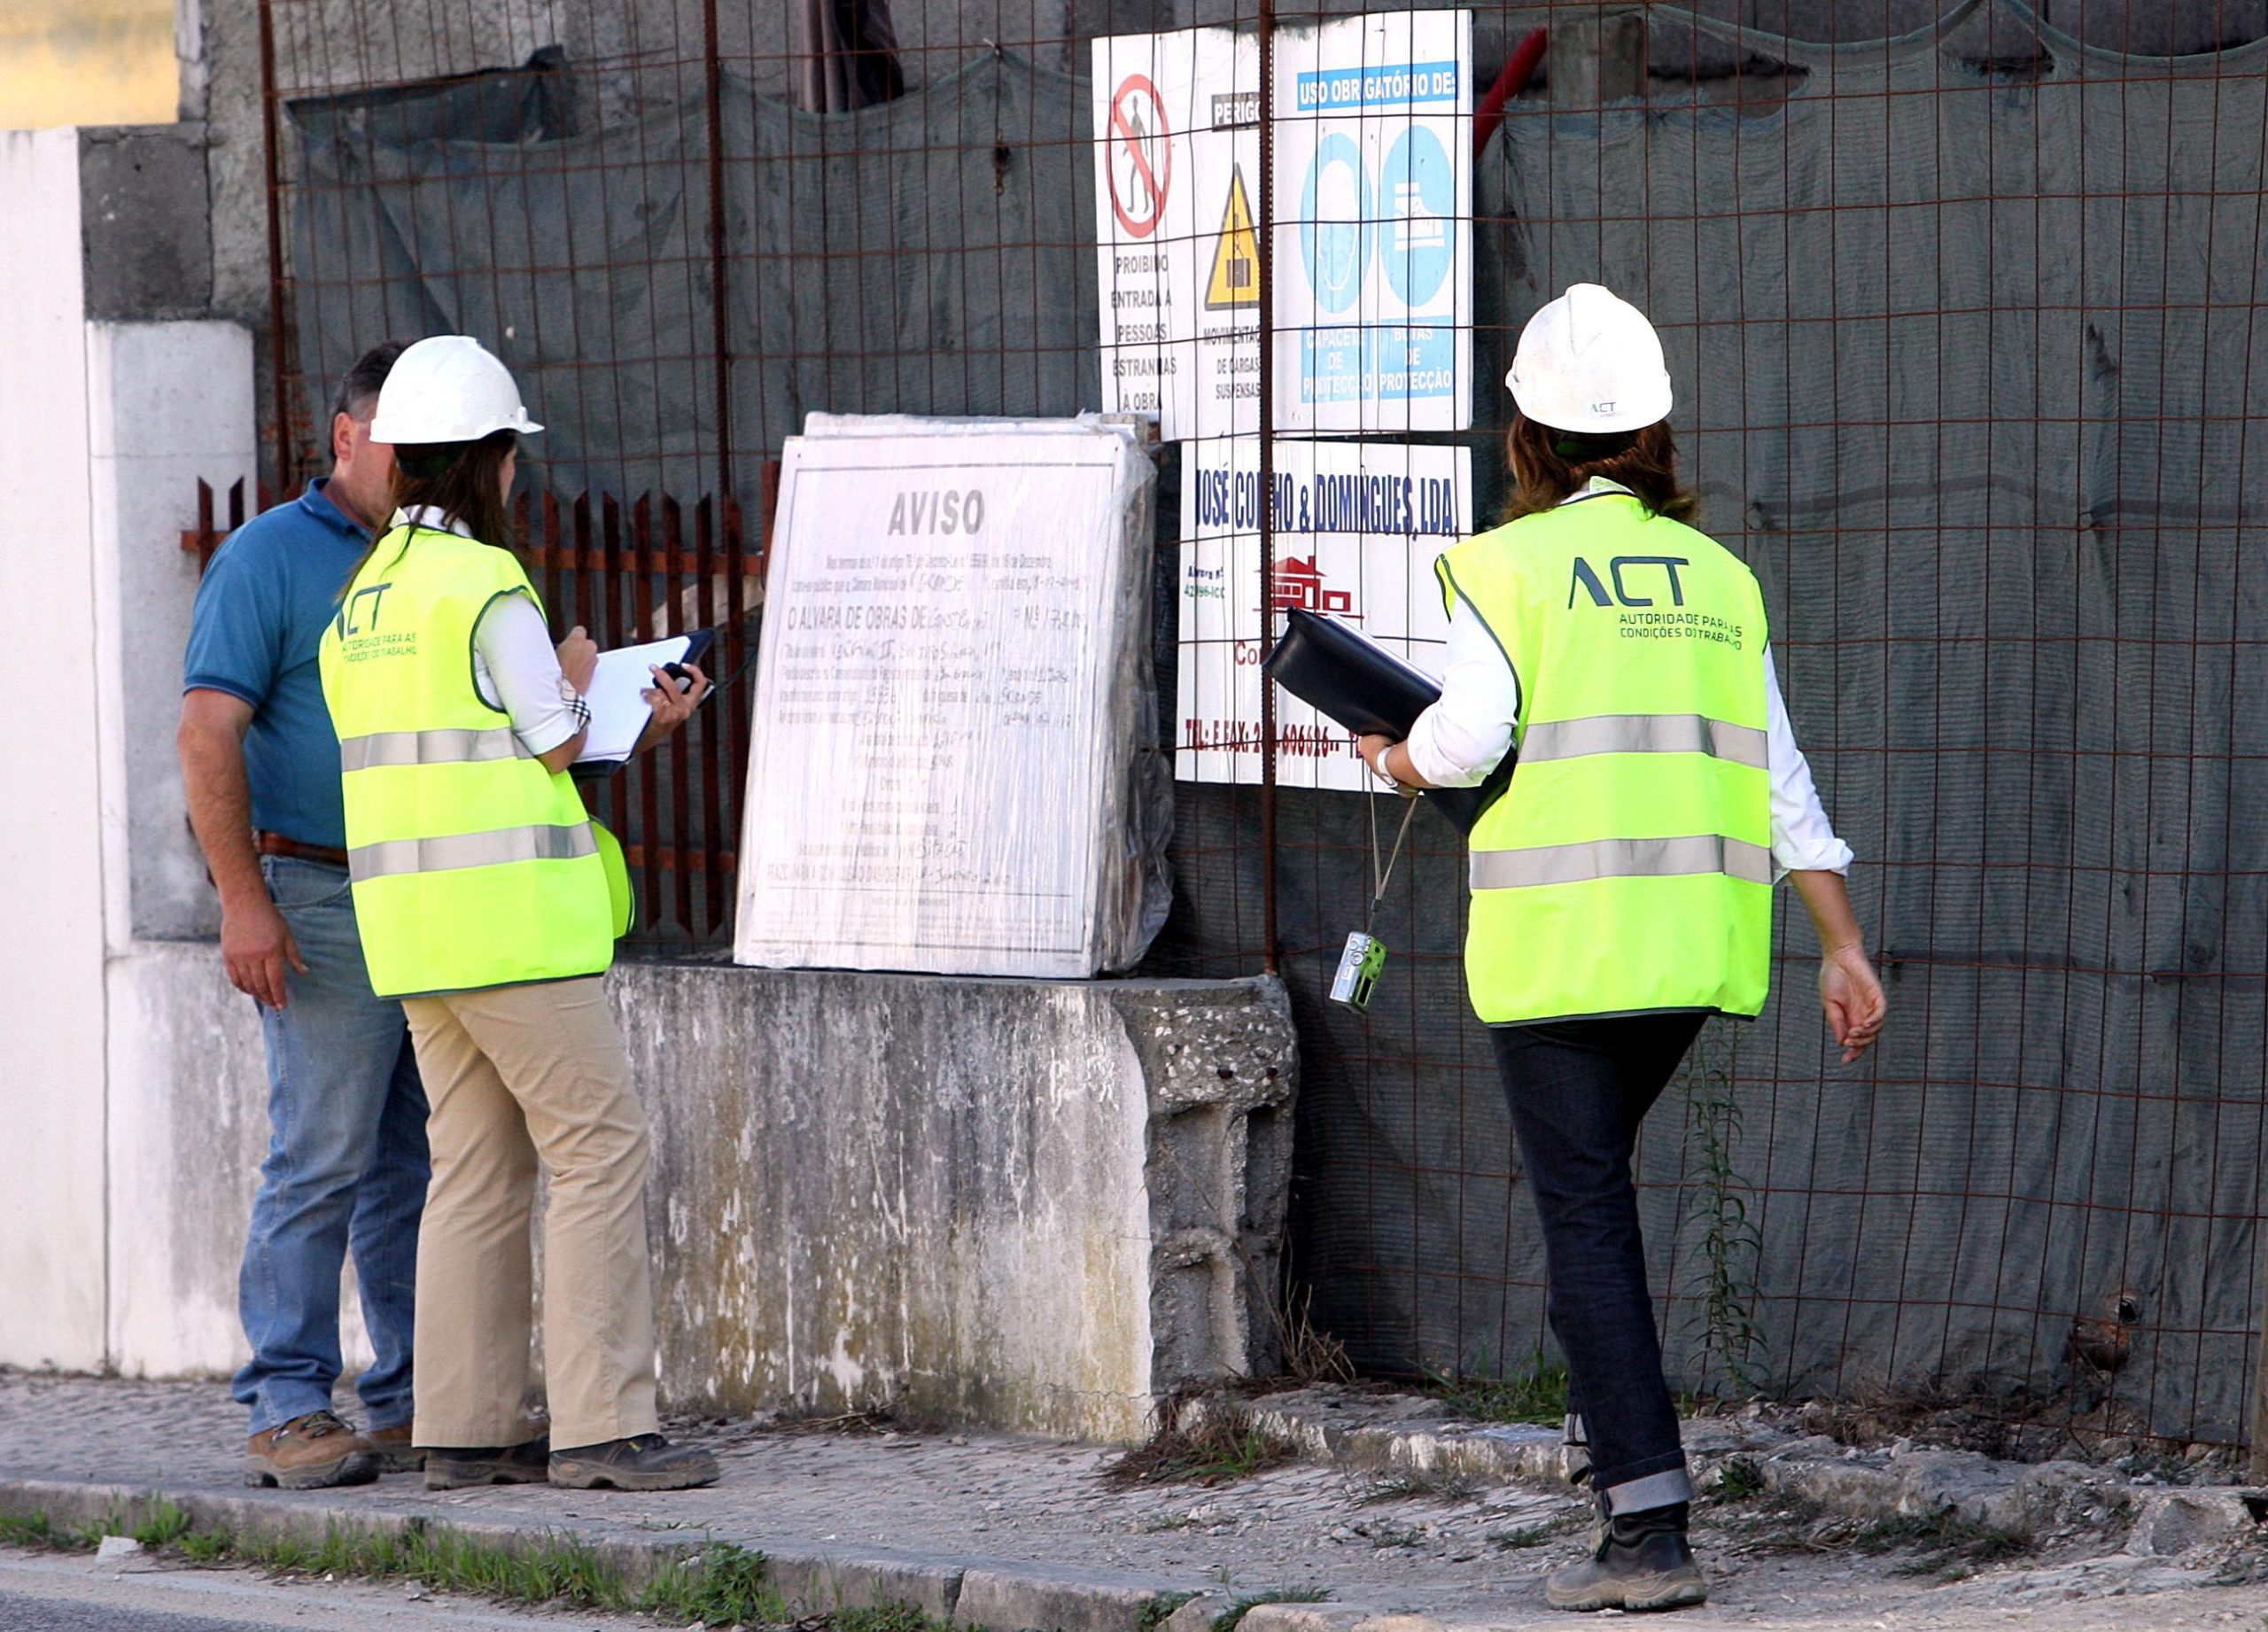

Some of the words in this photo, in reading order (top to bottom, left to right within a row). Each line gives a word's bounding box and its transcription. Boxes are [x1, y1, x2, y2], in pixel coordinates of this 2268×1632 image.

[1301, 82, 1328, 105] USO
[1117, 323, 1167, 342] PESSOAS
[1217, 358, 1227, 375] DE
[1329, 351, 1344, 369] DE
[1380, 367, 1452, 393] PROTECÇÃO
[1133, 392, 1162, 410] OBRA
[1588, 401, 1617, 413] ACT
[1196, 462, 1229, 527] JOSÉ
[1235, 470, 1293, 531] COHO
[1299, 485, 1310, 533] &
[887, 489, 985, 536] AVISO
[1568, 556, 1689, 610] ACT
[846, 606, 863, 630] DE
[866, 606, 907, 630] OBRAS
[911, 606, 928, 630] DE
[1619, 613, 1699, 626] AUTORIDADE
[1620, 626, 1682, 640] CONDIÇÕES
[1185, 719, 1210, 750] TEL:
[1214, 720, 1220, 750] E
[1224, 720, 1249, 752] FAX:
